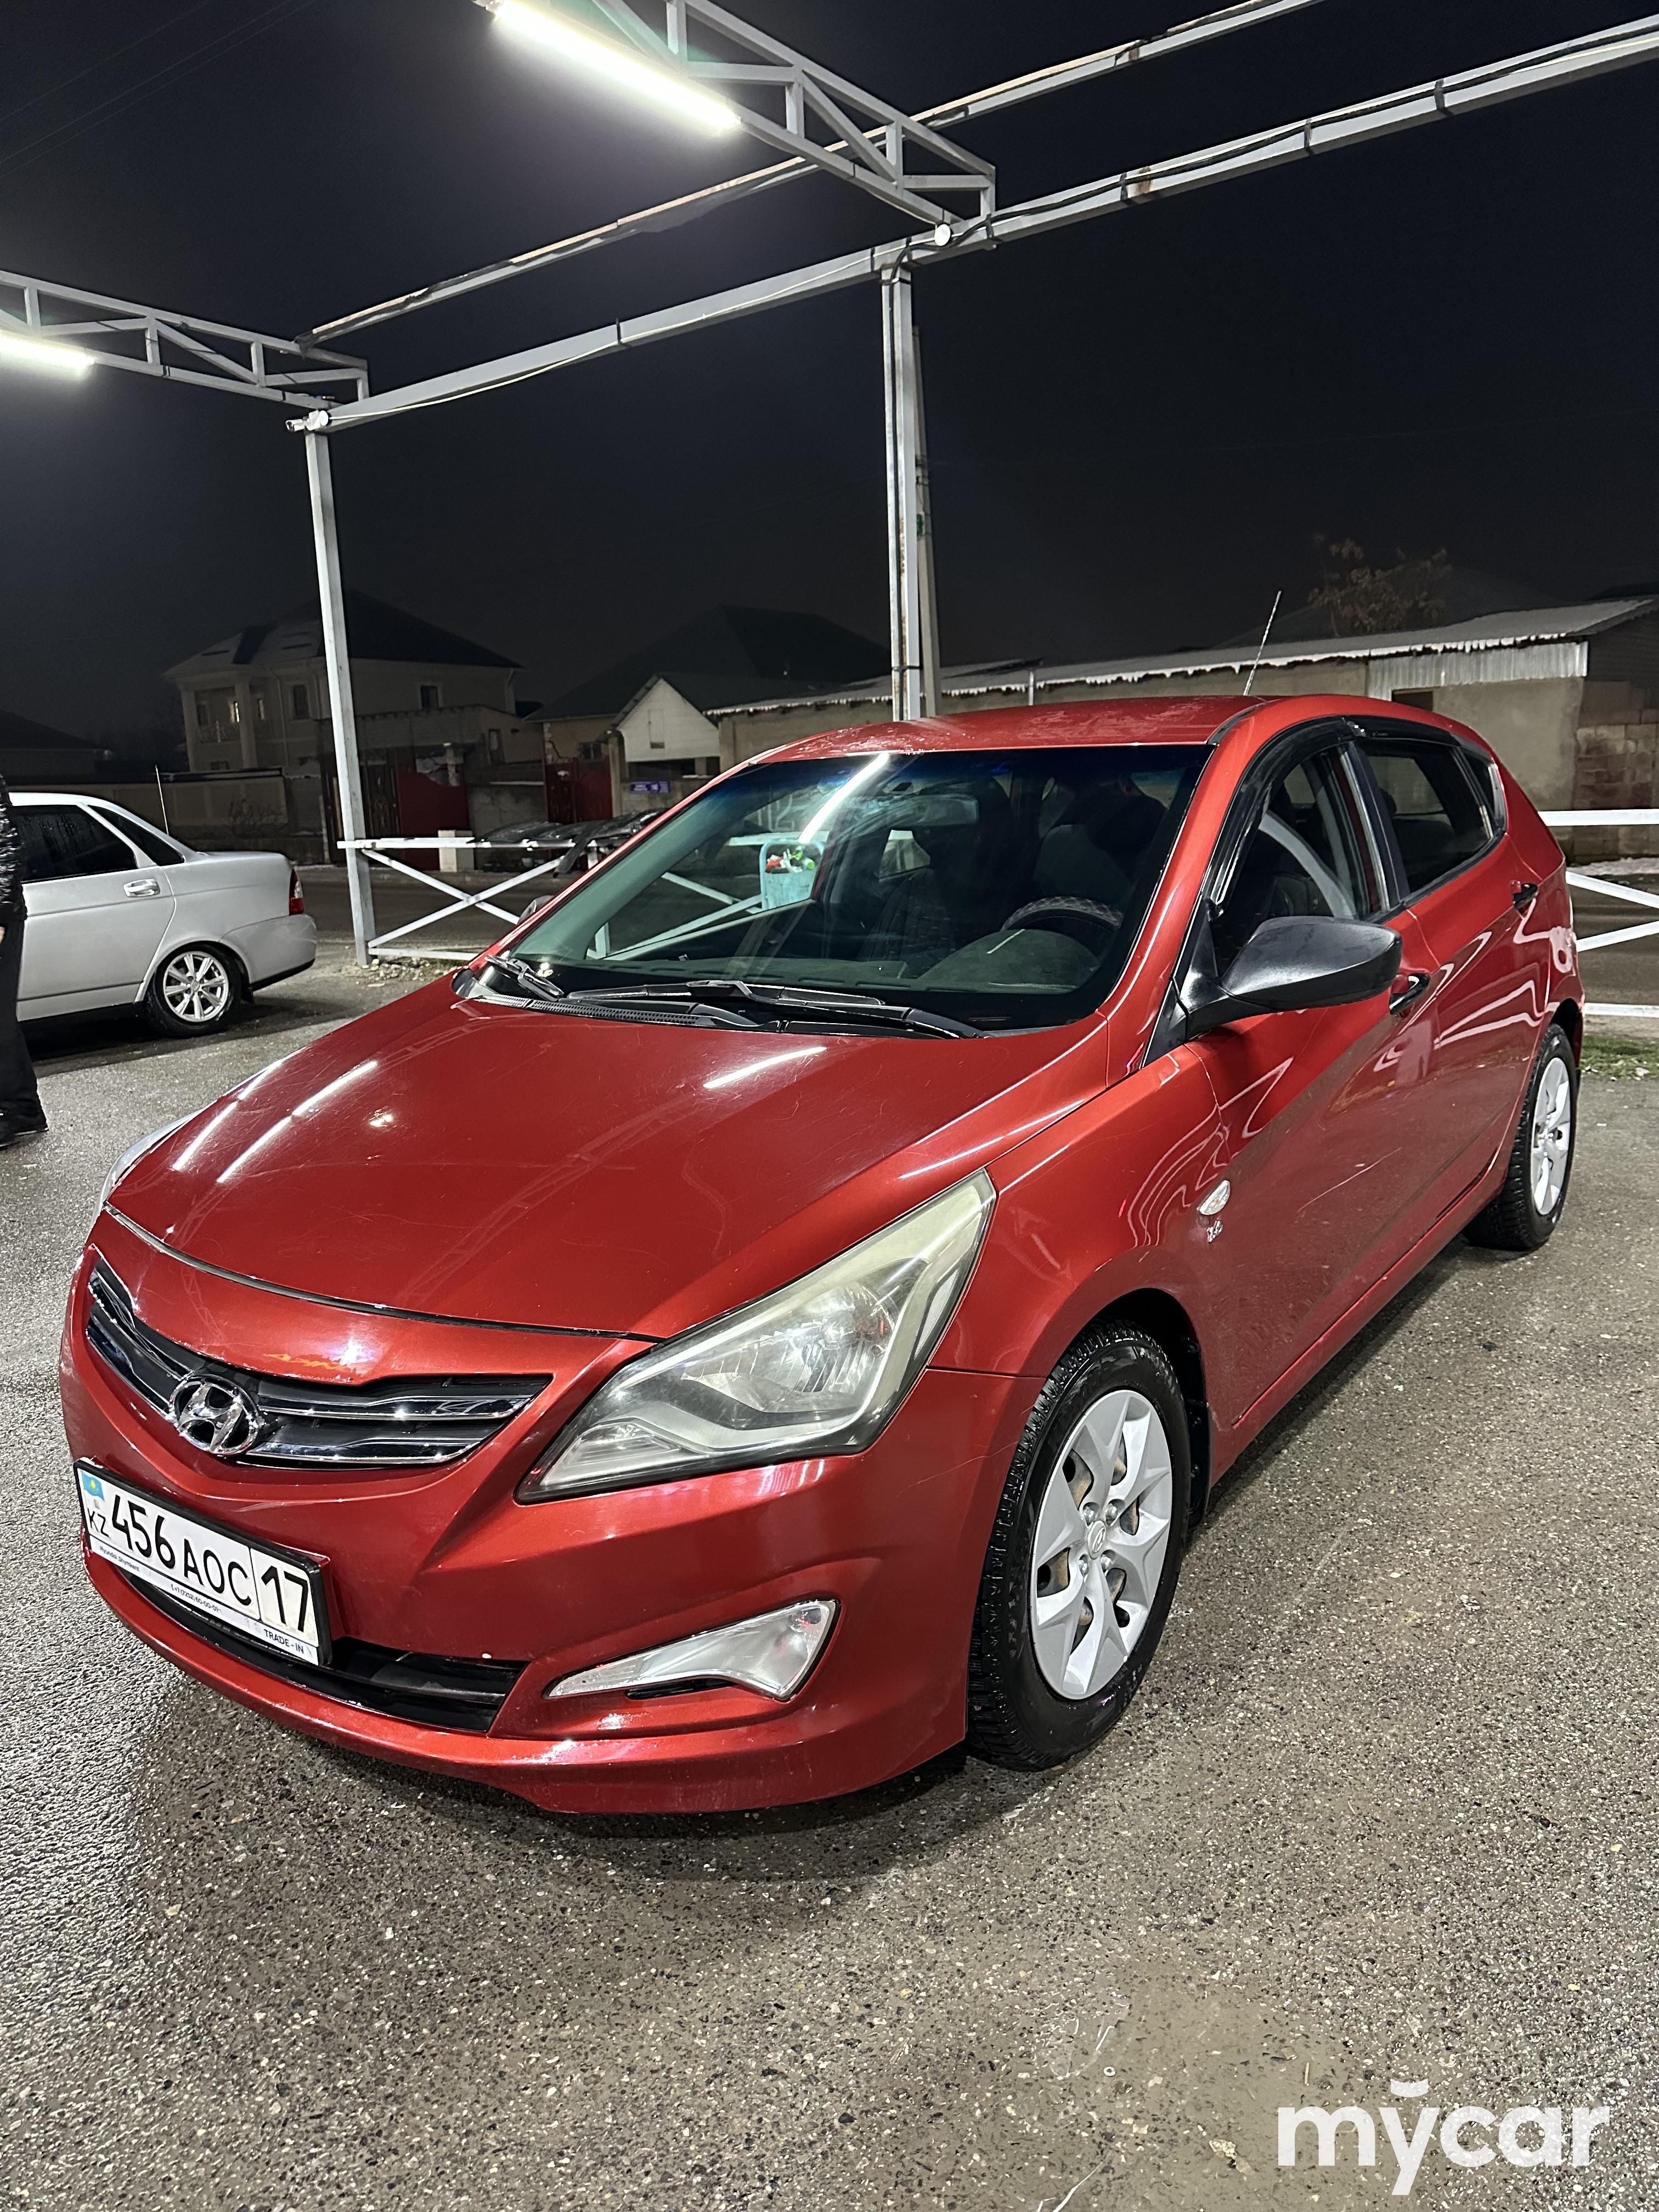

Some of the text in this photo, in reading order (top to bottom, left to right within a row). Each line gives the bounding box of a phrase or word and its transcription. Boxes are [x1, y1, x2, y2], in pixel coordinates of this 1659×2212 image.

[88, 1508, 110, 1538] KZ
[112, 1494, 309, 1632] 456 AOC 17
